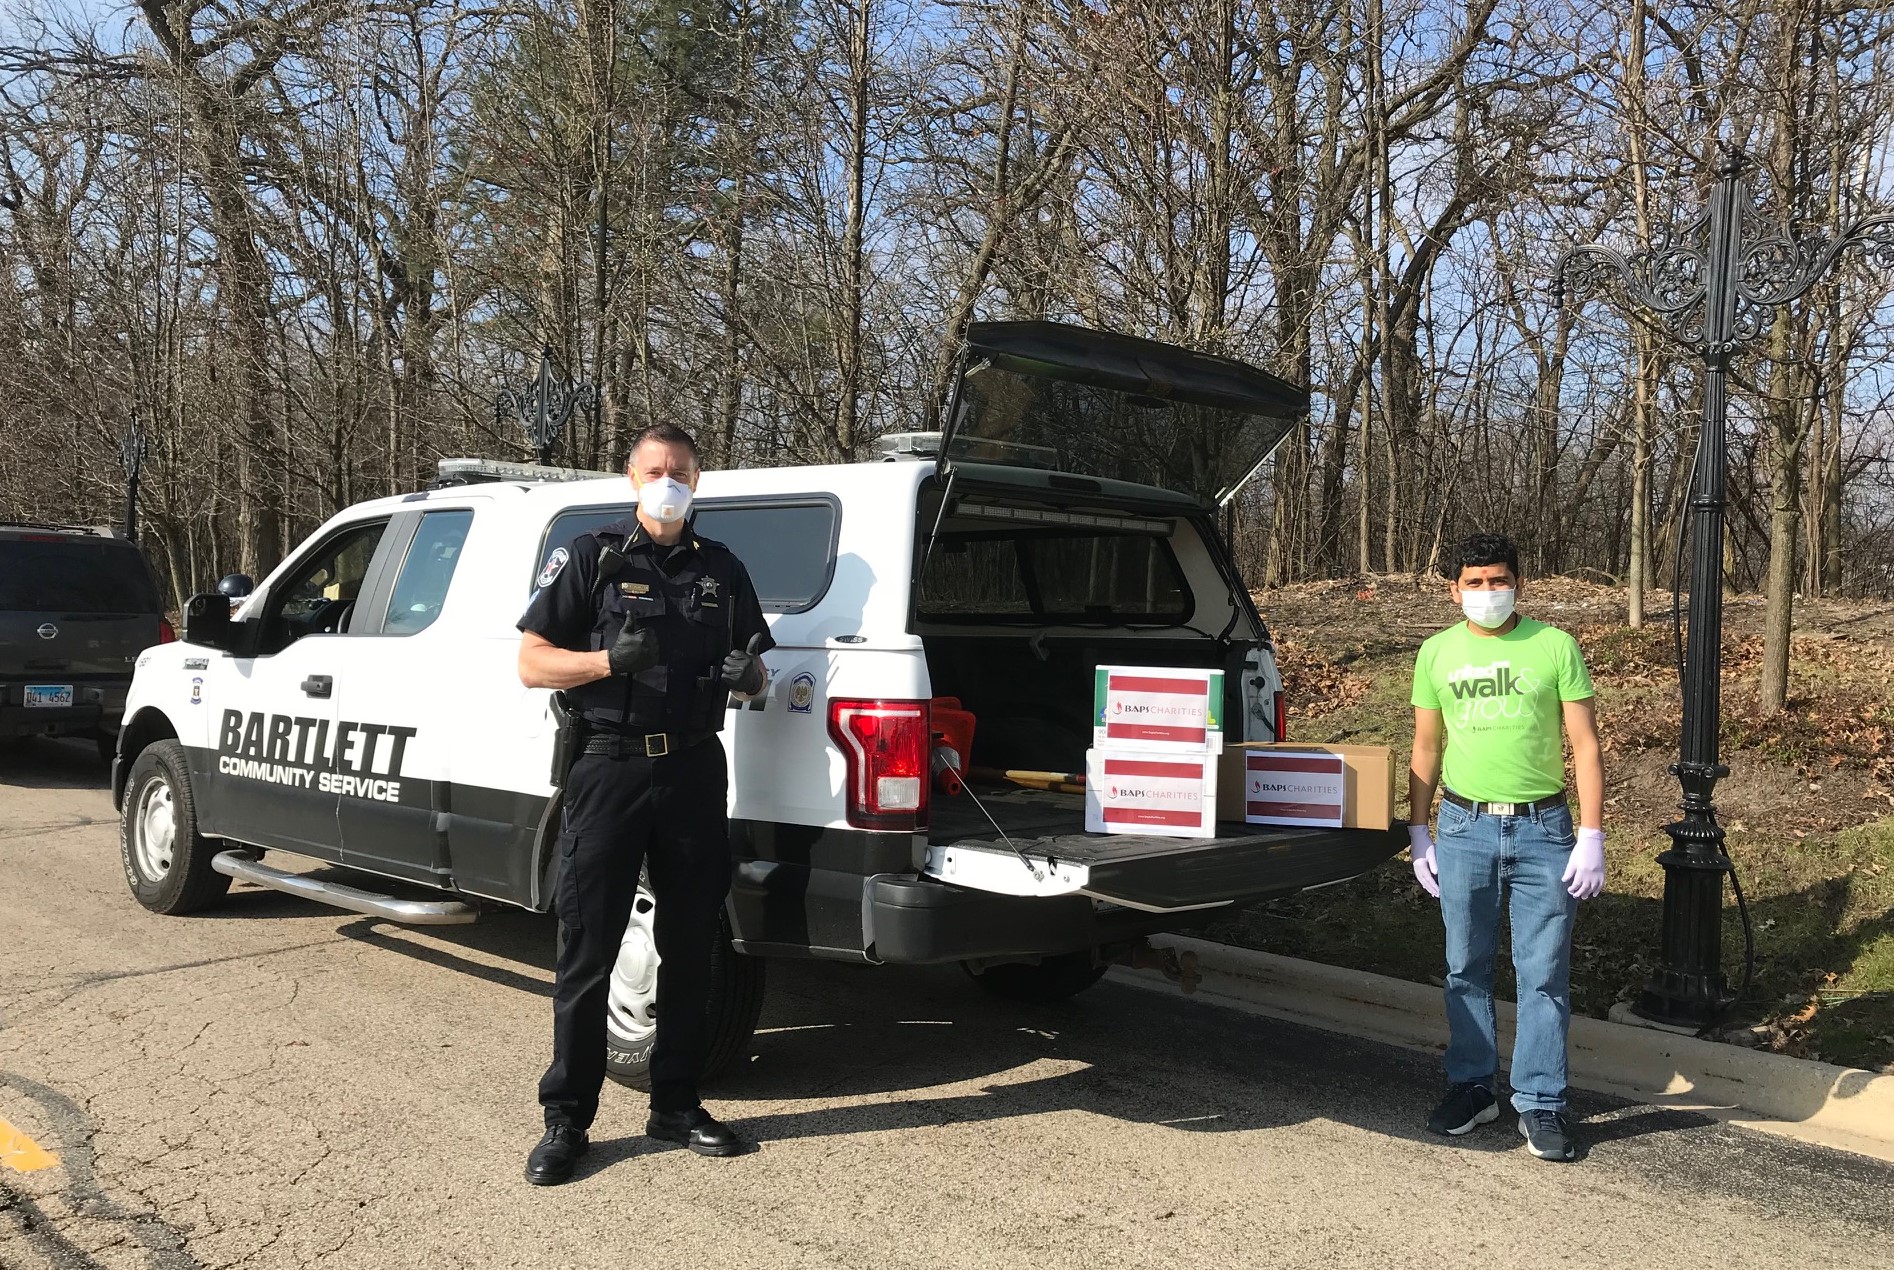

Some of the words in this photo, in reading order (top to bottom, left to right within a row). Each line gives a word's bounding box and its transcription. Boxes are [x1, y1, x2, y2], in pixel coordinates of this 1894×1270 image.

[1449, 668, 1524, 699] walk
[1124, 704, 1150, 713] BAPS
[1150, 705, 1203, 717] CHARITIES
[218, 708, 418, 777] BARTLETT
[218, 755, 315, 789] COMMUNITY
[318, 771, 401, 803] SERVICE
[1262, 783, 1287, 792] BAPS
[1287, 784, 1338, 795] CHARITIES
[1120, 788, 1145, 797] BAPS
[1145, 789, 1199, 801] CHARITIES
